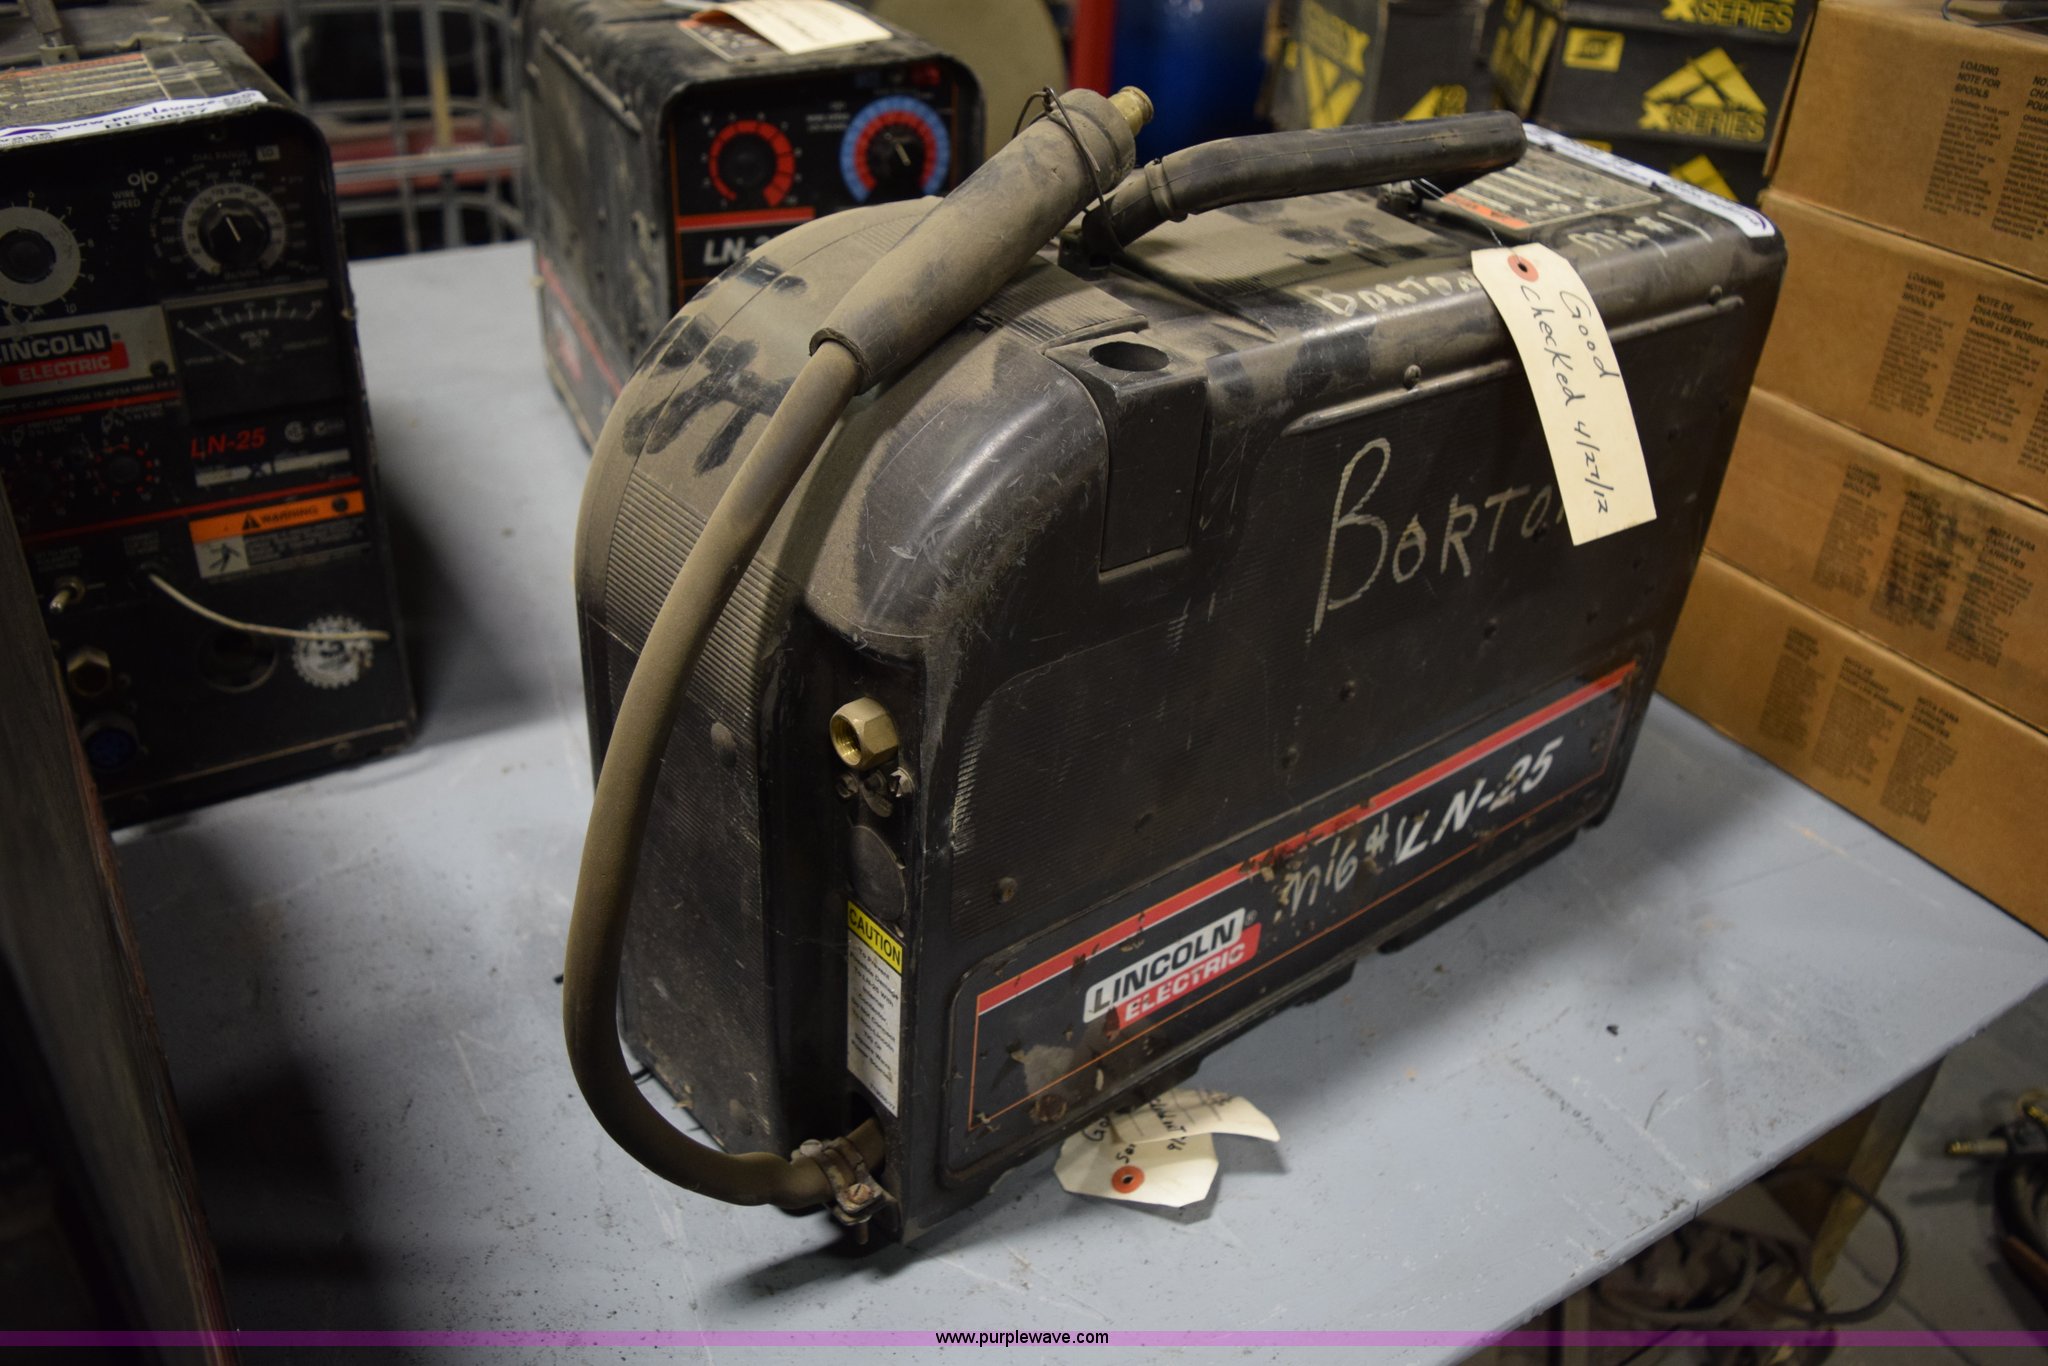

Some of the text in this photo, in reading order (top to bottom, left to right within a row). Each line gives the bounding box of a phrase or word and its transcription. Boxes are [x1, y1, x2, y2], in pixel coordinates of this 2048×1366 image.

[0, 329, 106, 364] INCOLN
[18, 355, 111, 381] ELECTRIC
[1559, 290, 1621, 379] Good
[190, 426, 268, 460] LN-25
[1573, 420, 1615, 514] 4/27/12
[1395, 736, 1564, 865] LN-25
[849, 908, 901, 967] CAUTION
[1091, 916, 1237, 1014] LINCOLN
[1124, 943, 1246, 1022] ELECTRIC
